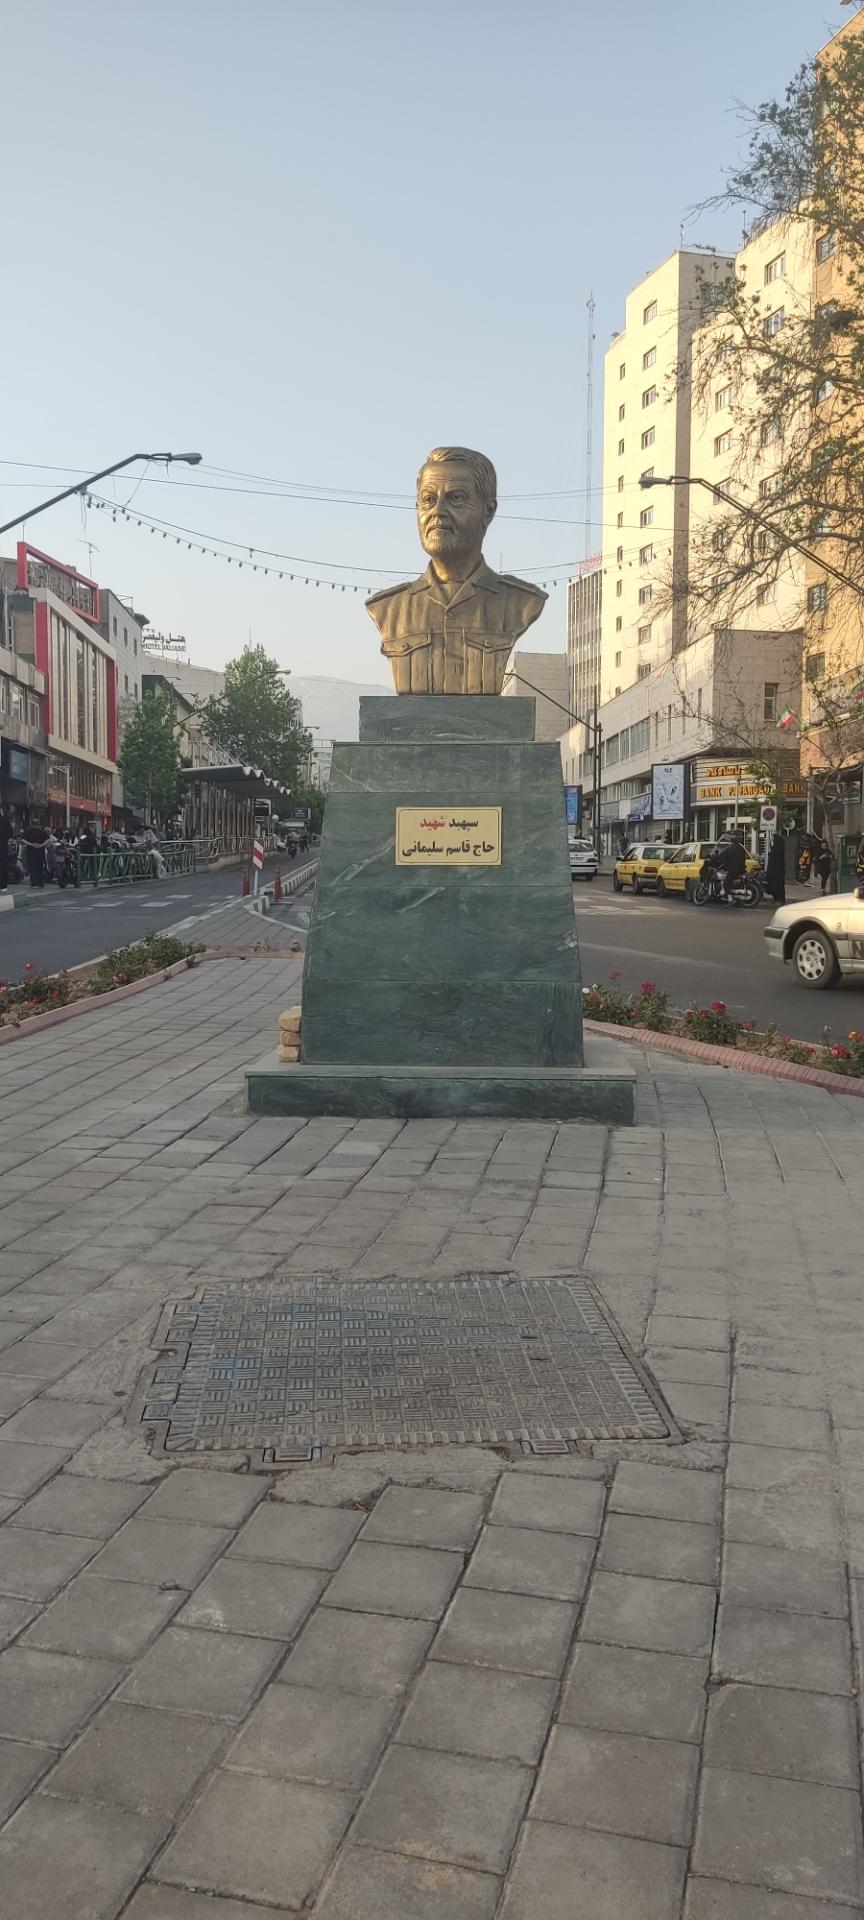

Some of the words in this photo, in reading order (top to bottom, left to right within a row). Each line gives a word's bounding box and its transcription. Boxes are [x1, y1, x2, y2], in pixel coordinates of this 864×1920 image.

[165, 633, 185, 644] هتل
[700, 787, 722, 798] BANK
[420, 816, 445, 831] شهید
[449, 818, 479, 831] سپهبد
[402, 840, 444, 857] سلیمانی
[446, 839, 471, 856] قاسم
[473, 841, 494, 856] حاج
